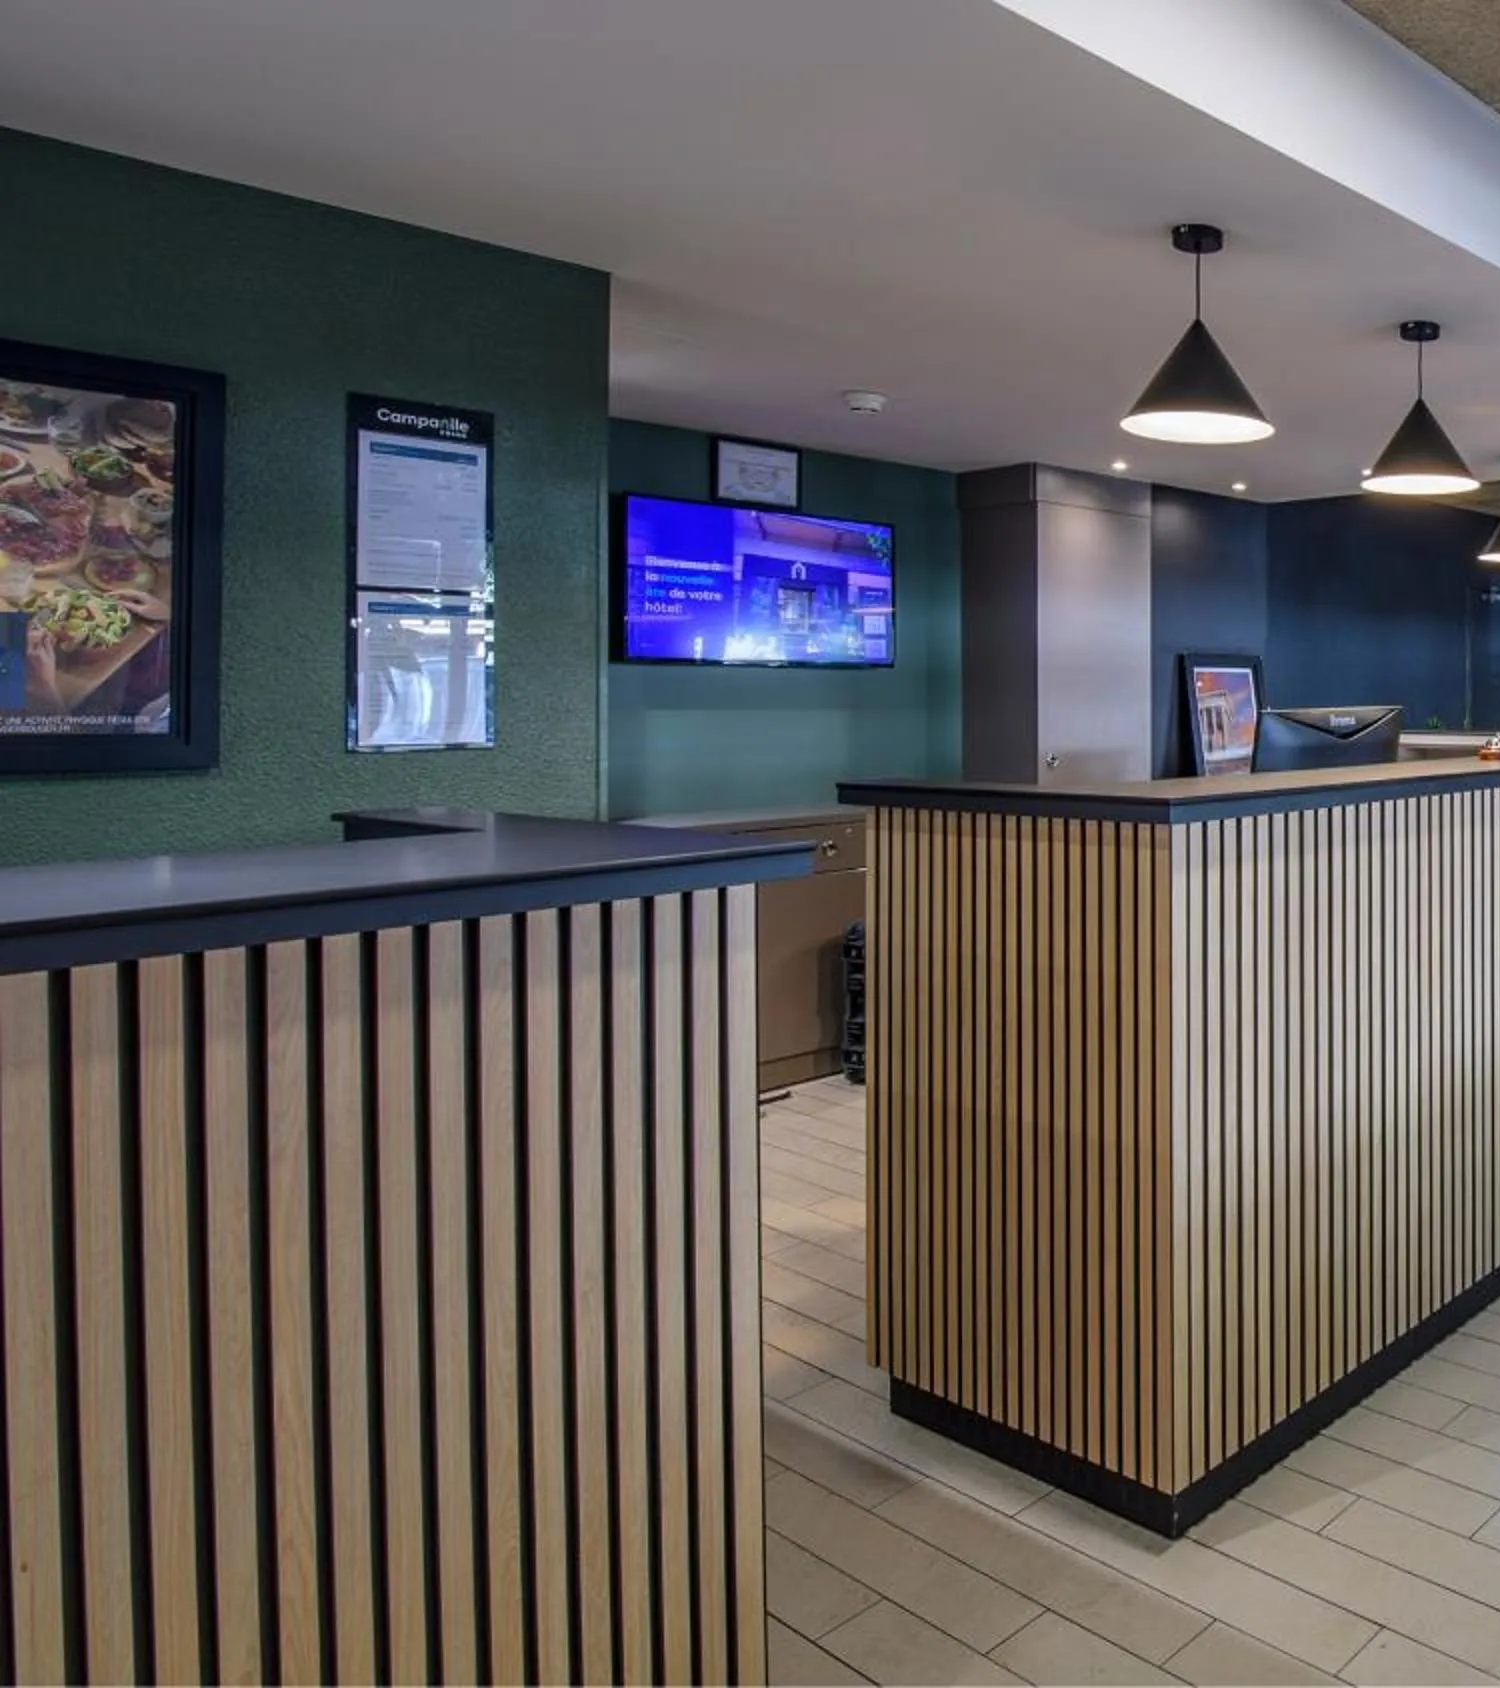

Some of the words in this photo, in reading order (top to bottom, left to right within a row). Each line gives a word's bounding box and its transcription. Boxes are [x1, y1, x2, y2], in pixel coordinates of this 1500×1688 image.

[377, 408, 471, 433] Campanile
[645, 571, 659, 582] la
[669, 588, 686, 600] de
[688, 590, 723, 602] votre
